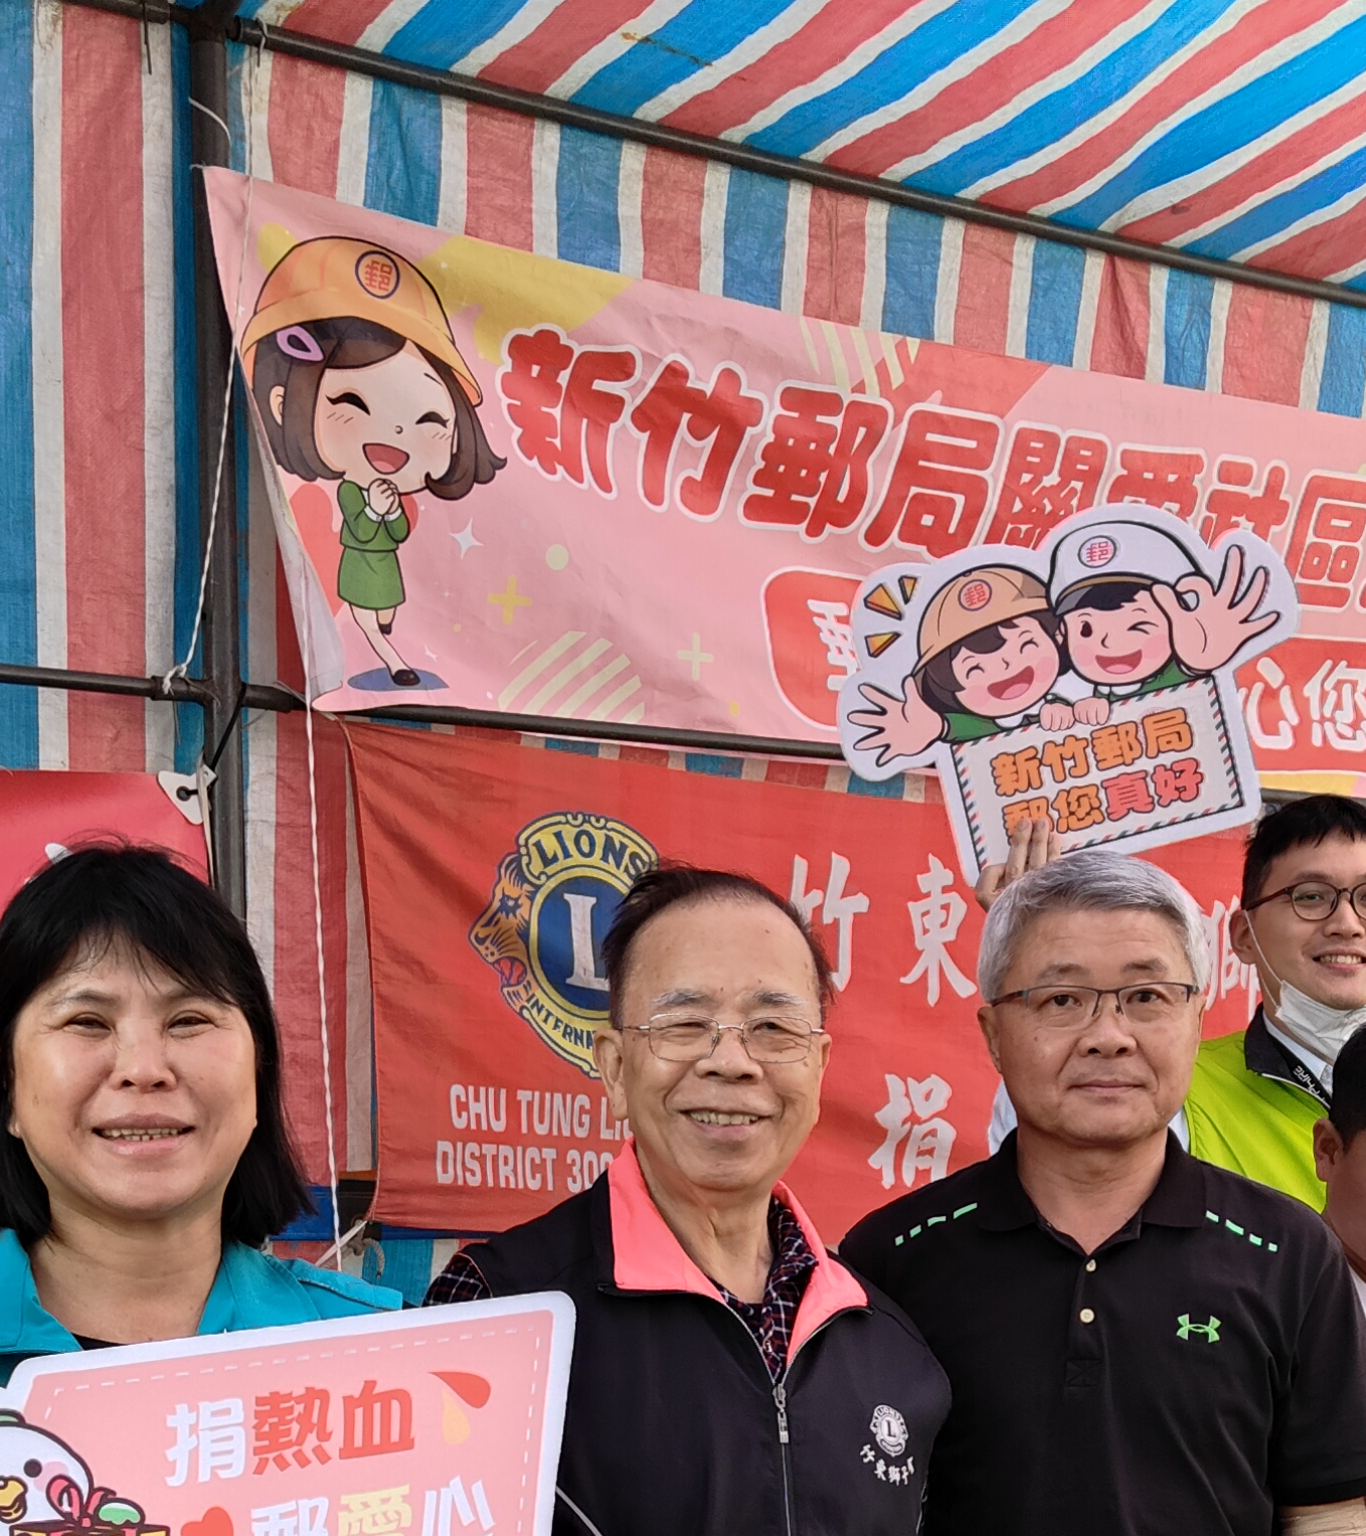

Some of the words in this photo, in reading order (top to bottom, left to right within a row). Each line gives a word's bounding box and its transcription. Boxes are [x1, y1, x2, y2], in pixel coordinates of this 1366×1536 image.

[990, 706, 1194, 798] 新竹郵局
[532, 829, 649, 874] LIONS
[449, 1082, 507, 1133] CHU
[516, 1089, 591, 1138] TUNG
[436, 1139, 557, 1191] DISTRICT
[164, 1380, 416, 1488] 捐熱血
